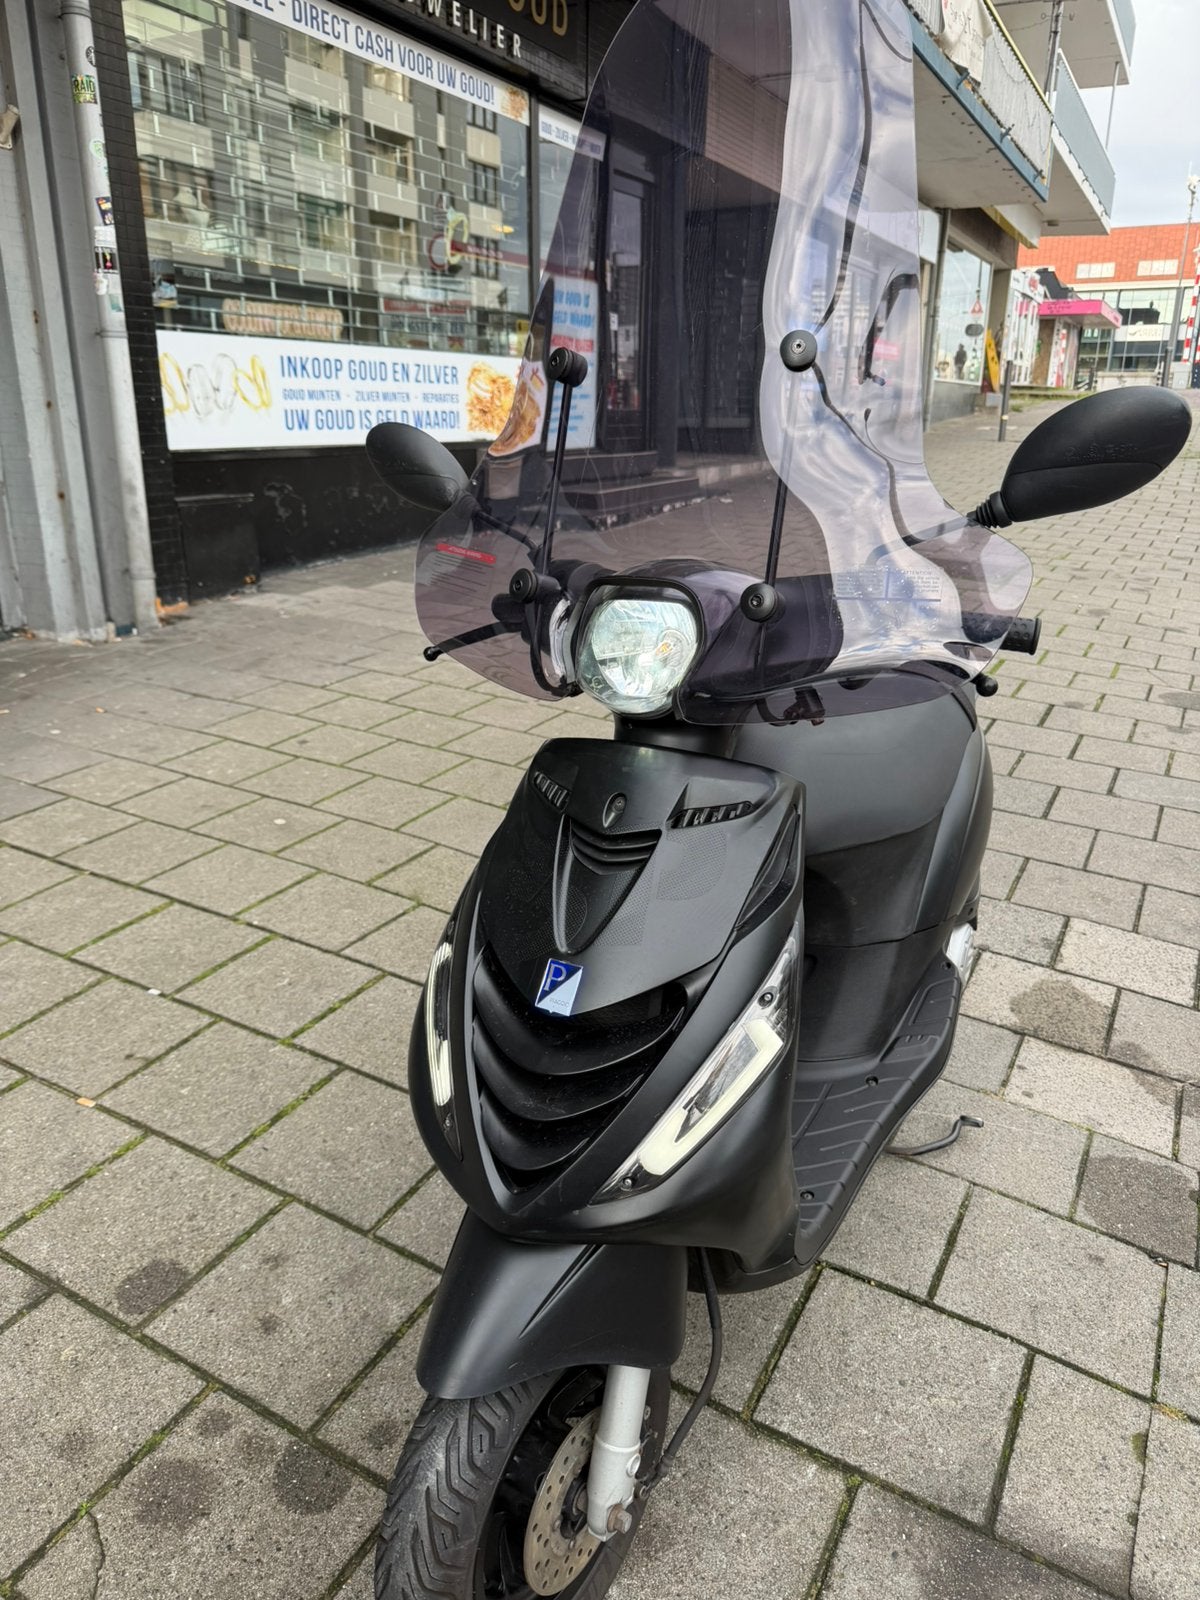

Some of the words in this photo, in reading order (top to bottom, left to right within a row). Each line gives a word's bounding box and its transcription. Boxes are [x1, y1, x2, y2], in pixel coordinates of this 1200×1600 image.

[407, 0, 522, 58] WELIER
[292, 0, 349, 43] DIRECT
[355, 25, 394, 63] CASH
[398, 43, 434, 80] VOOR
[437, 61, 457, 89] UW
[460, 72, 496, 105] GOUD!
[280, 355, 343, 380] INKOOP
[349, 359, 388, 382] GOUD
[392, 362, 410, 383] EN
[414, 363, 459, 385] ZILVER
[307, 389, 341, 401] MUNTEN
[355, 390, 379, 402] ZILVER
[382, 391, 410, 403] MUNTEN
[284, 409, 310, 431] UW
[315, 409, 355, 431] GOUD
[359, 409, 373, 430] IS
[413, 410, 460, 429] WAARD!
[544, 962, 567, 991] P
